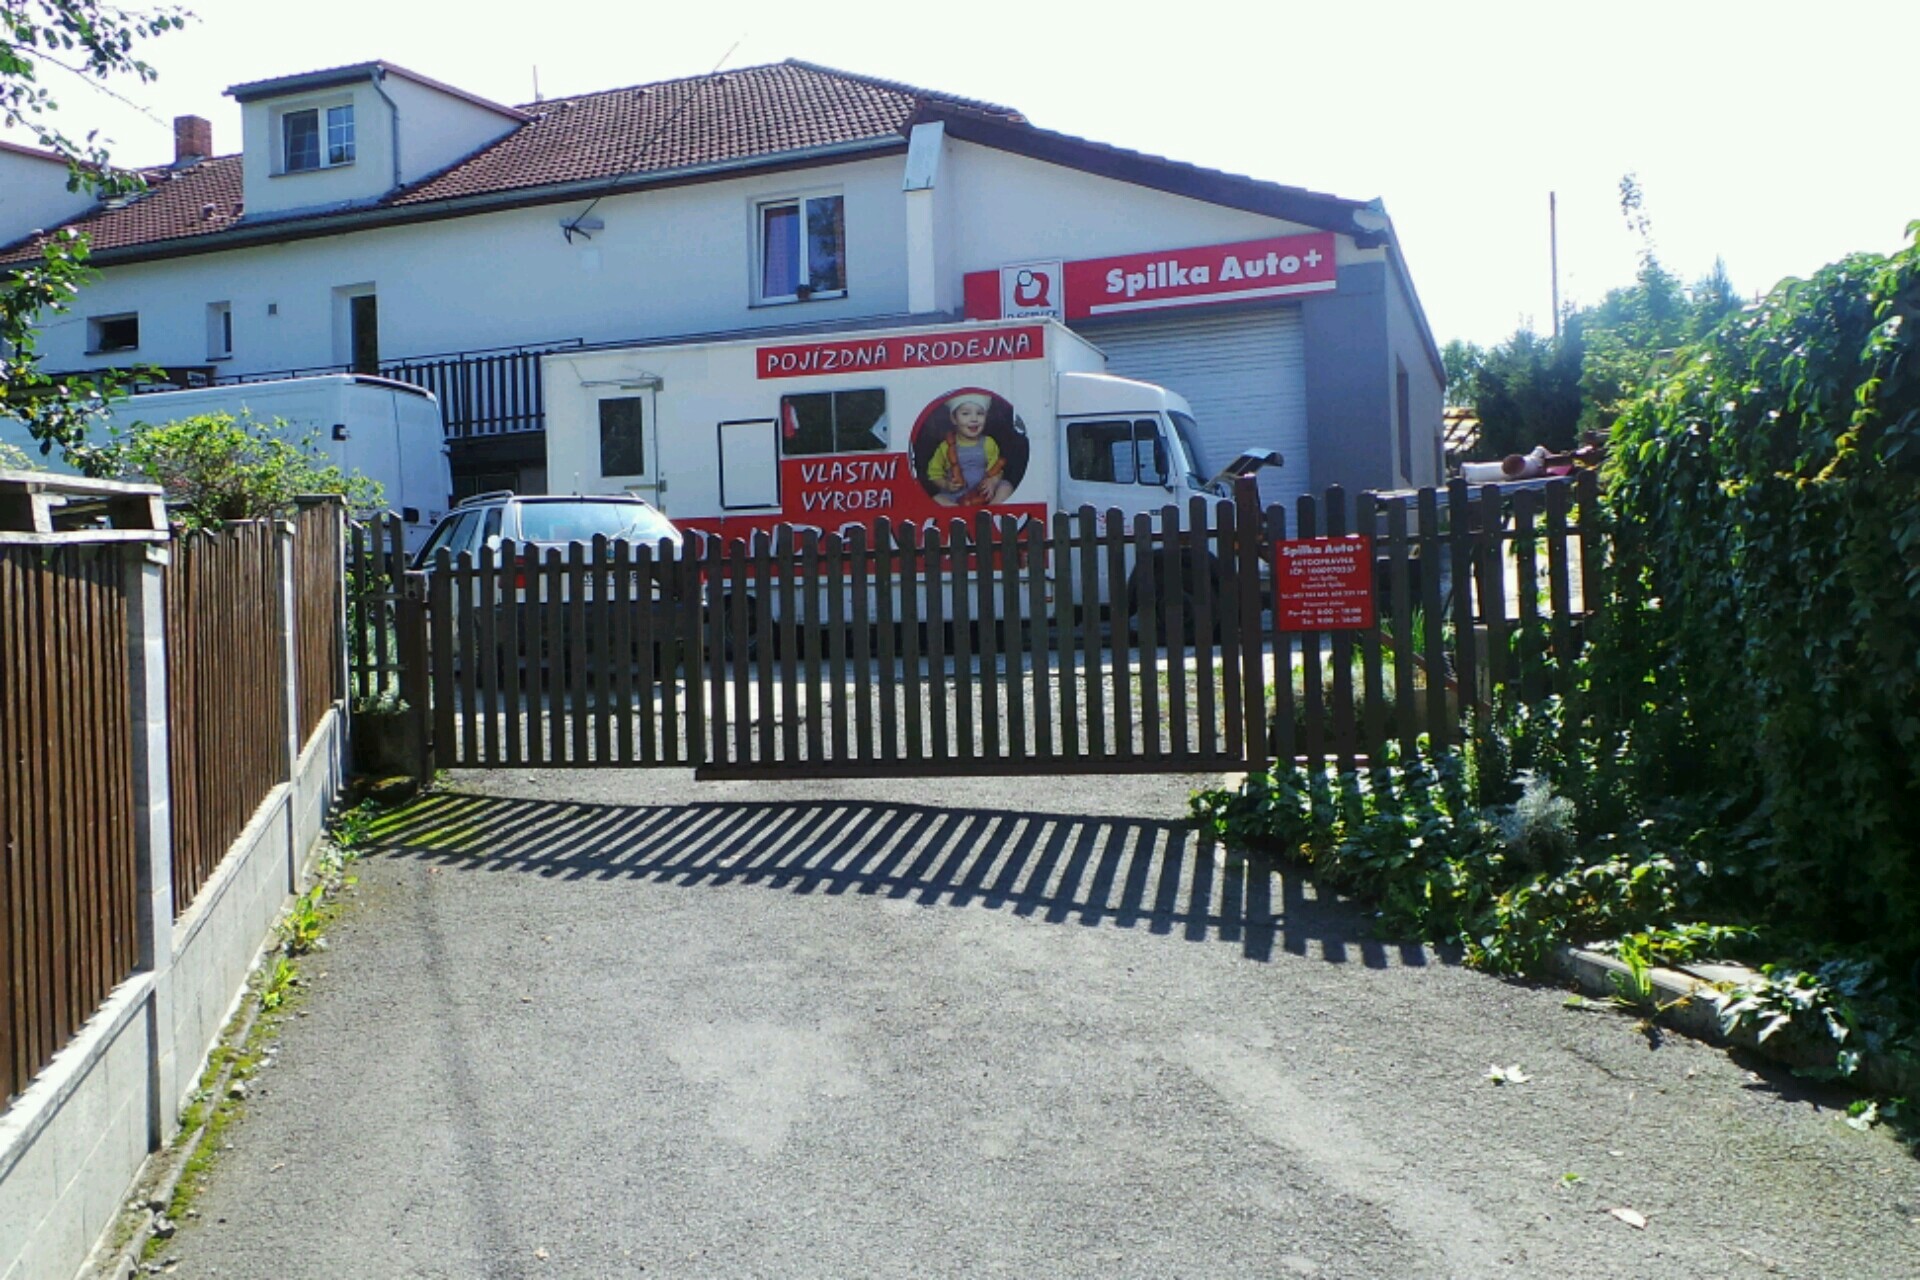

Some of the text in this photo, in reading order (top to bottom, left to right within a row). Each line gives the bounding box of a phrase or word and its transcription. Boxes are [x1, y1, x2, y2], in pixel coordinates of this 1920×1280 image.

[1106, 249, 1323, 297] Spilka Auto+
[767, 333, 1031, 373] POJÍZDNÁ PRODEJNA
[801, 455, 899, 483] VLASTNÍ
[801, 486, 893, 512] VÝROBA
[1282, 545, 1322, 558] Spilka
